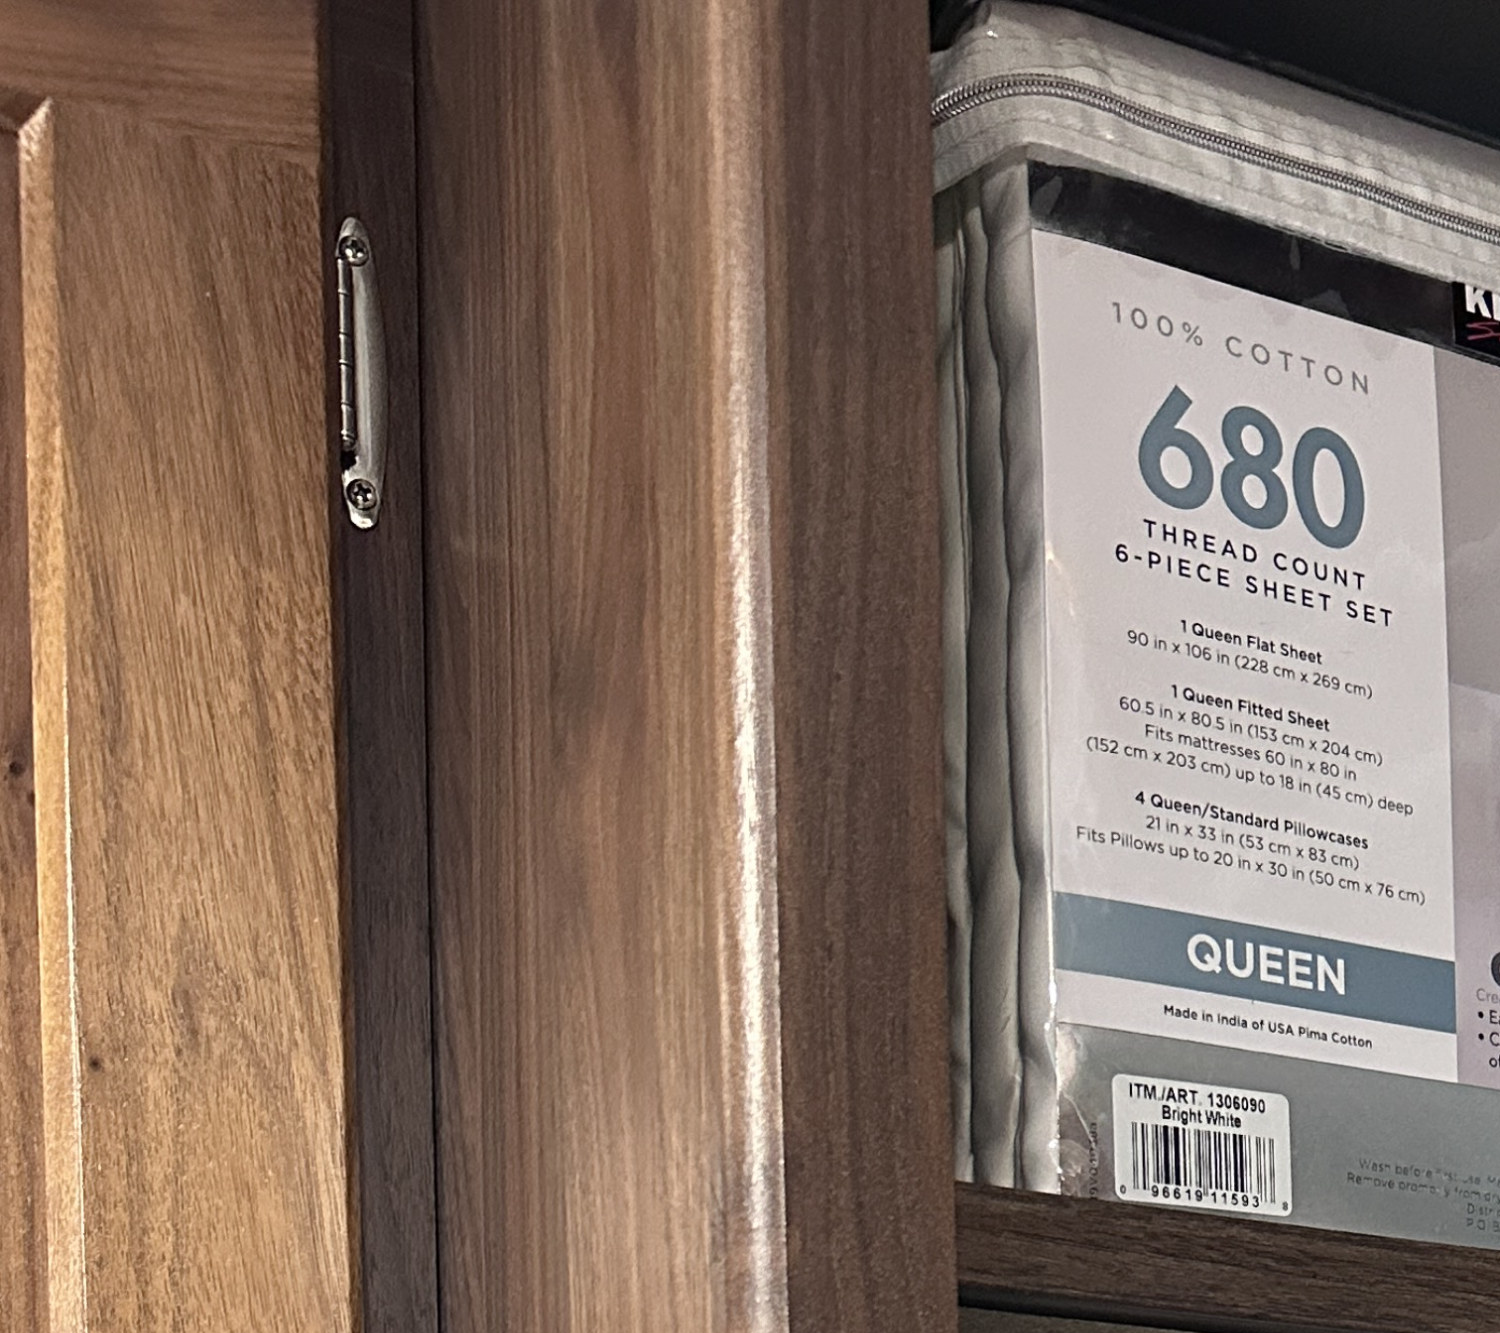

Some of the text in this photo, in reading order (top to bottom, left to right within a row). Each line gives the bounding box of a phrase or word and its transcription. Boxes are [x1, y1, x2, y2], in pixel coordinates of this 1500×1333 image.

[1112, 301, 1369, 395] 100% COTTON
[1138, 384, 1366, 549] 680
[1143, 518, 1365, 591] THREAD COUNT
[1115, 543, 1392, 627] 6-PIECE SHEET SET
[1127, 630, 1373, 699] 90 in x 106 in (228 cm x 269 cm)
[1180, 619, 1322, 665] 1 Queen Flat Sheet
[1159, 707, 1173, 720] in
[1177, 711, 1186, 723] x
[1229, 722, 1243, 735] in
[1247, 723, 1279, 743] (153
[1282, 734, 1306, 749] cm
[1309, 740, 1317, 751] x
[1321, 739, 1350, 758] 204
[1354, 750, 1383, 767] cm)
[1171, 684, 1330, 733] 1 Queen Fitted Sheet
[1086, 736, 1414, 816] (152 cm x 203 cm) up to 18 in (45 cm) deep
[1145, 724, 1357, 781] Fits mattresses 60 in x 80 in
[1135, 790, 1369, 850] 4 Queen/Standard Pillowcases
[1146, 815, 1359, 872] 21 in x 33 in (53 cm x 83 cm)
[1076, 825, 1426, 906] Fits Pillows up to 20 in x 30 in (50 cm x 76 cm)
[1187, 933, 1346, 996] QUEEN
[1163, 1004, 1373, 1049] Made in India of USA Pima Cotton
[1161, 1106, 1242, 1129] Bright White
[1207, 1092, 1266, 1114] 1306090
[1119, 1184, 1127, 1195] 0
